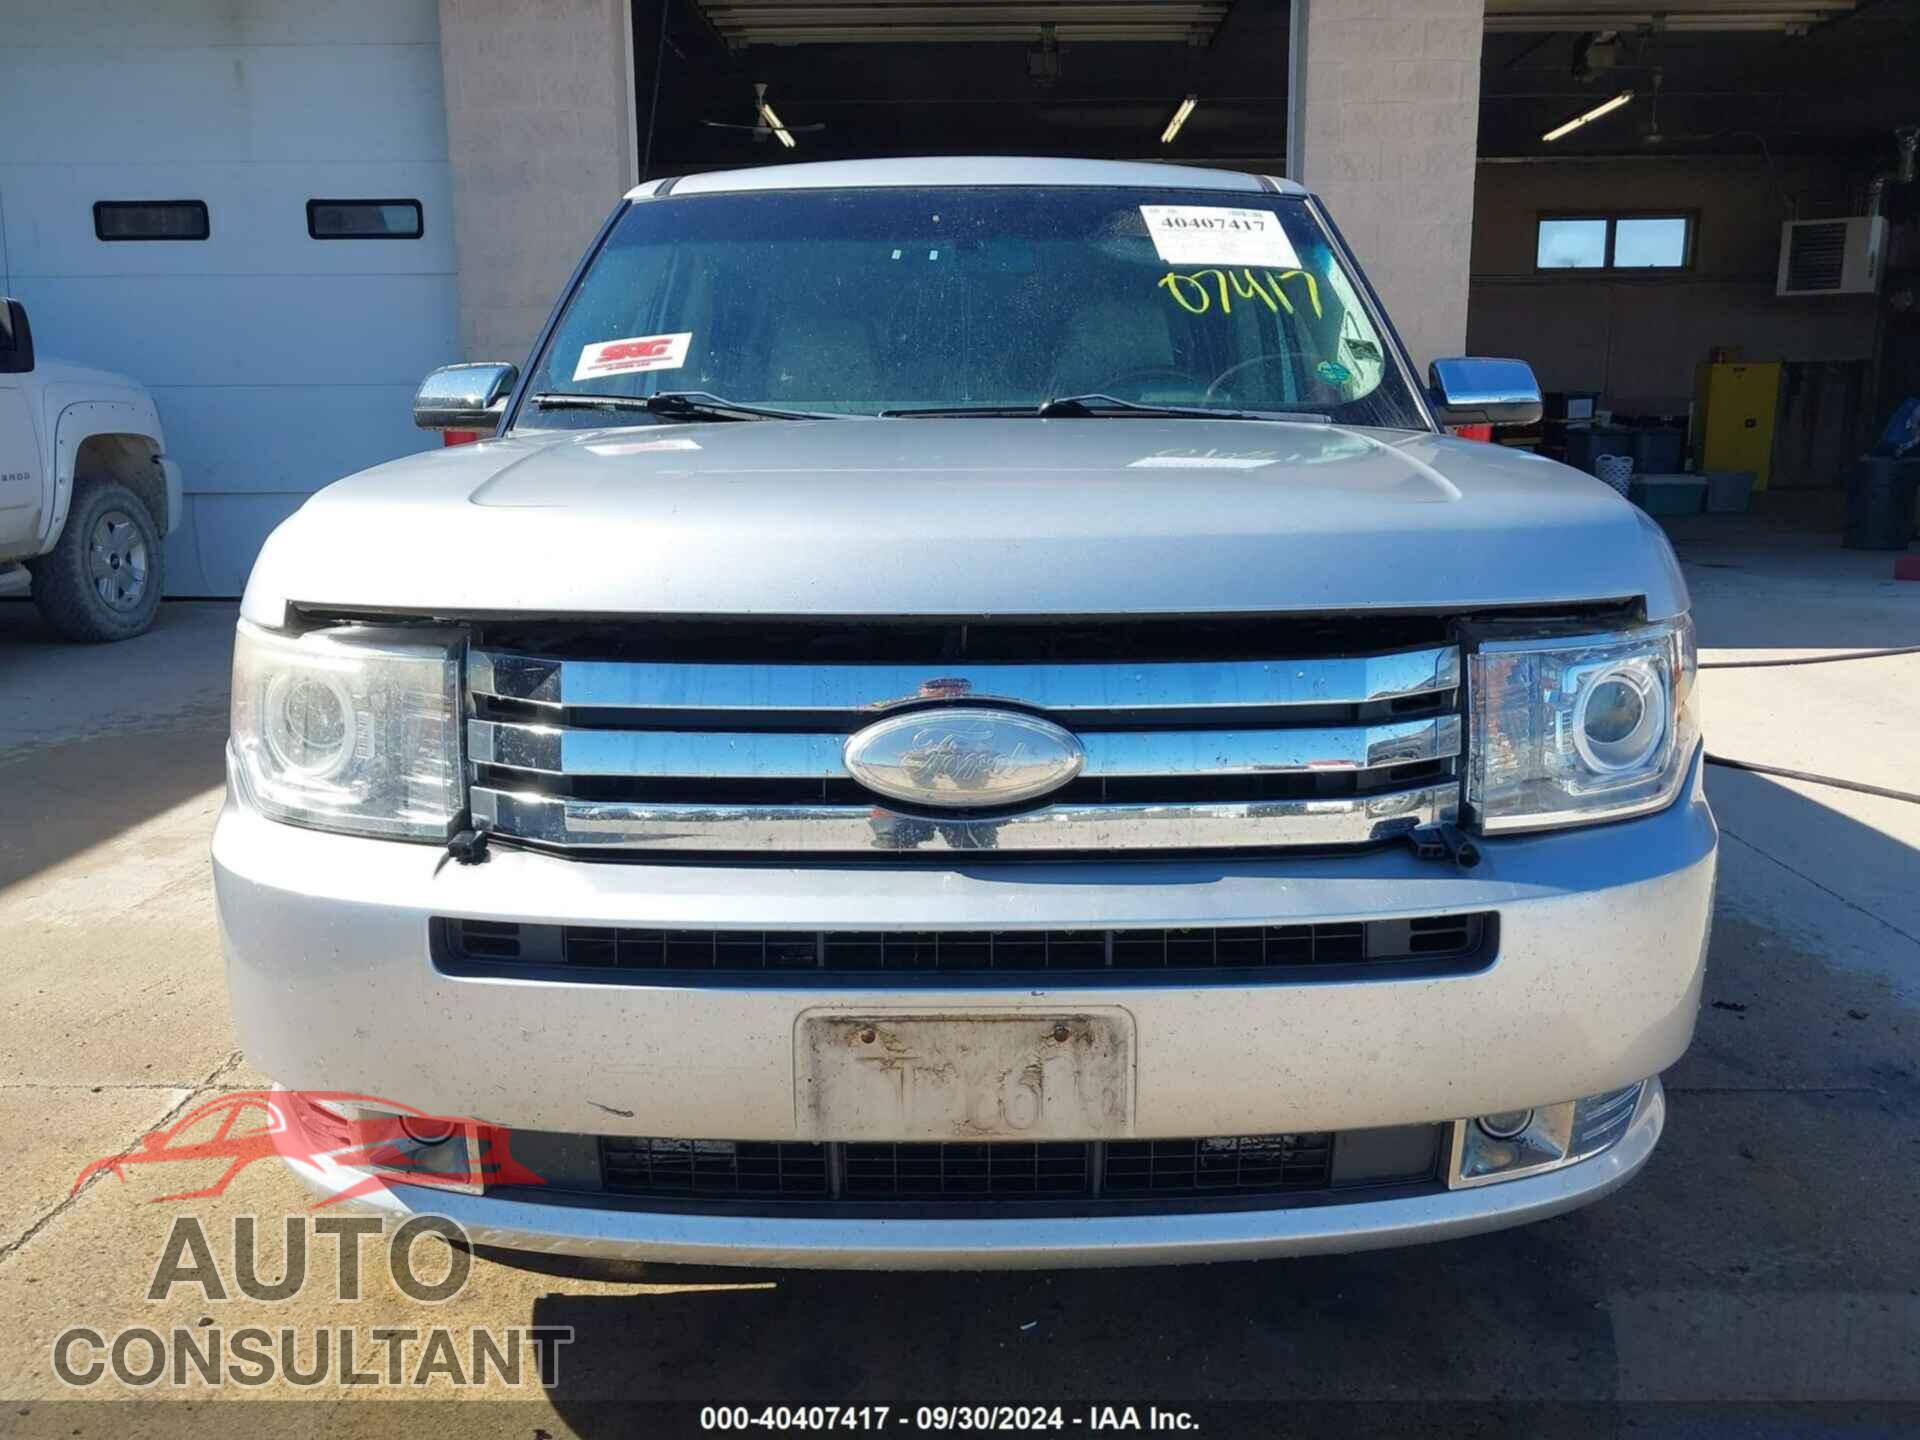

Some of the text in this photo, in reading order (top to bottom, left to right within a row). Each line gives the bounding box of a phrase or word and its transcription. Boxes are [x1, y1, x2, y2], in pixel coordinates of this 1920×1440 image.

[1161, 217, 1265, 232] 40407417
[1157, 268, 1322, 320] 07417
[899, 722, 1026, 780] Ford
